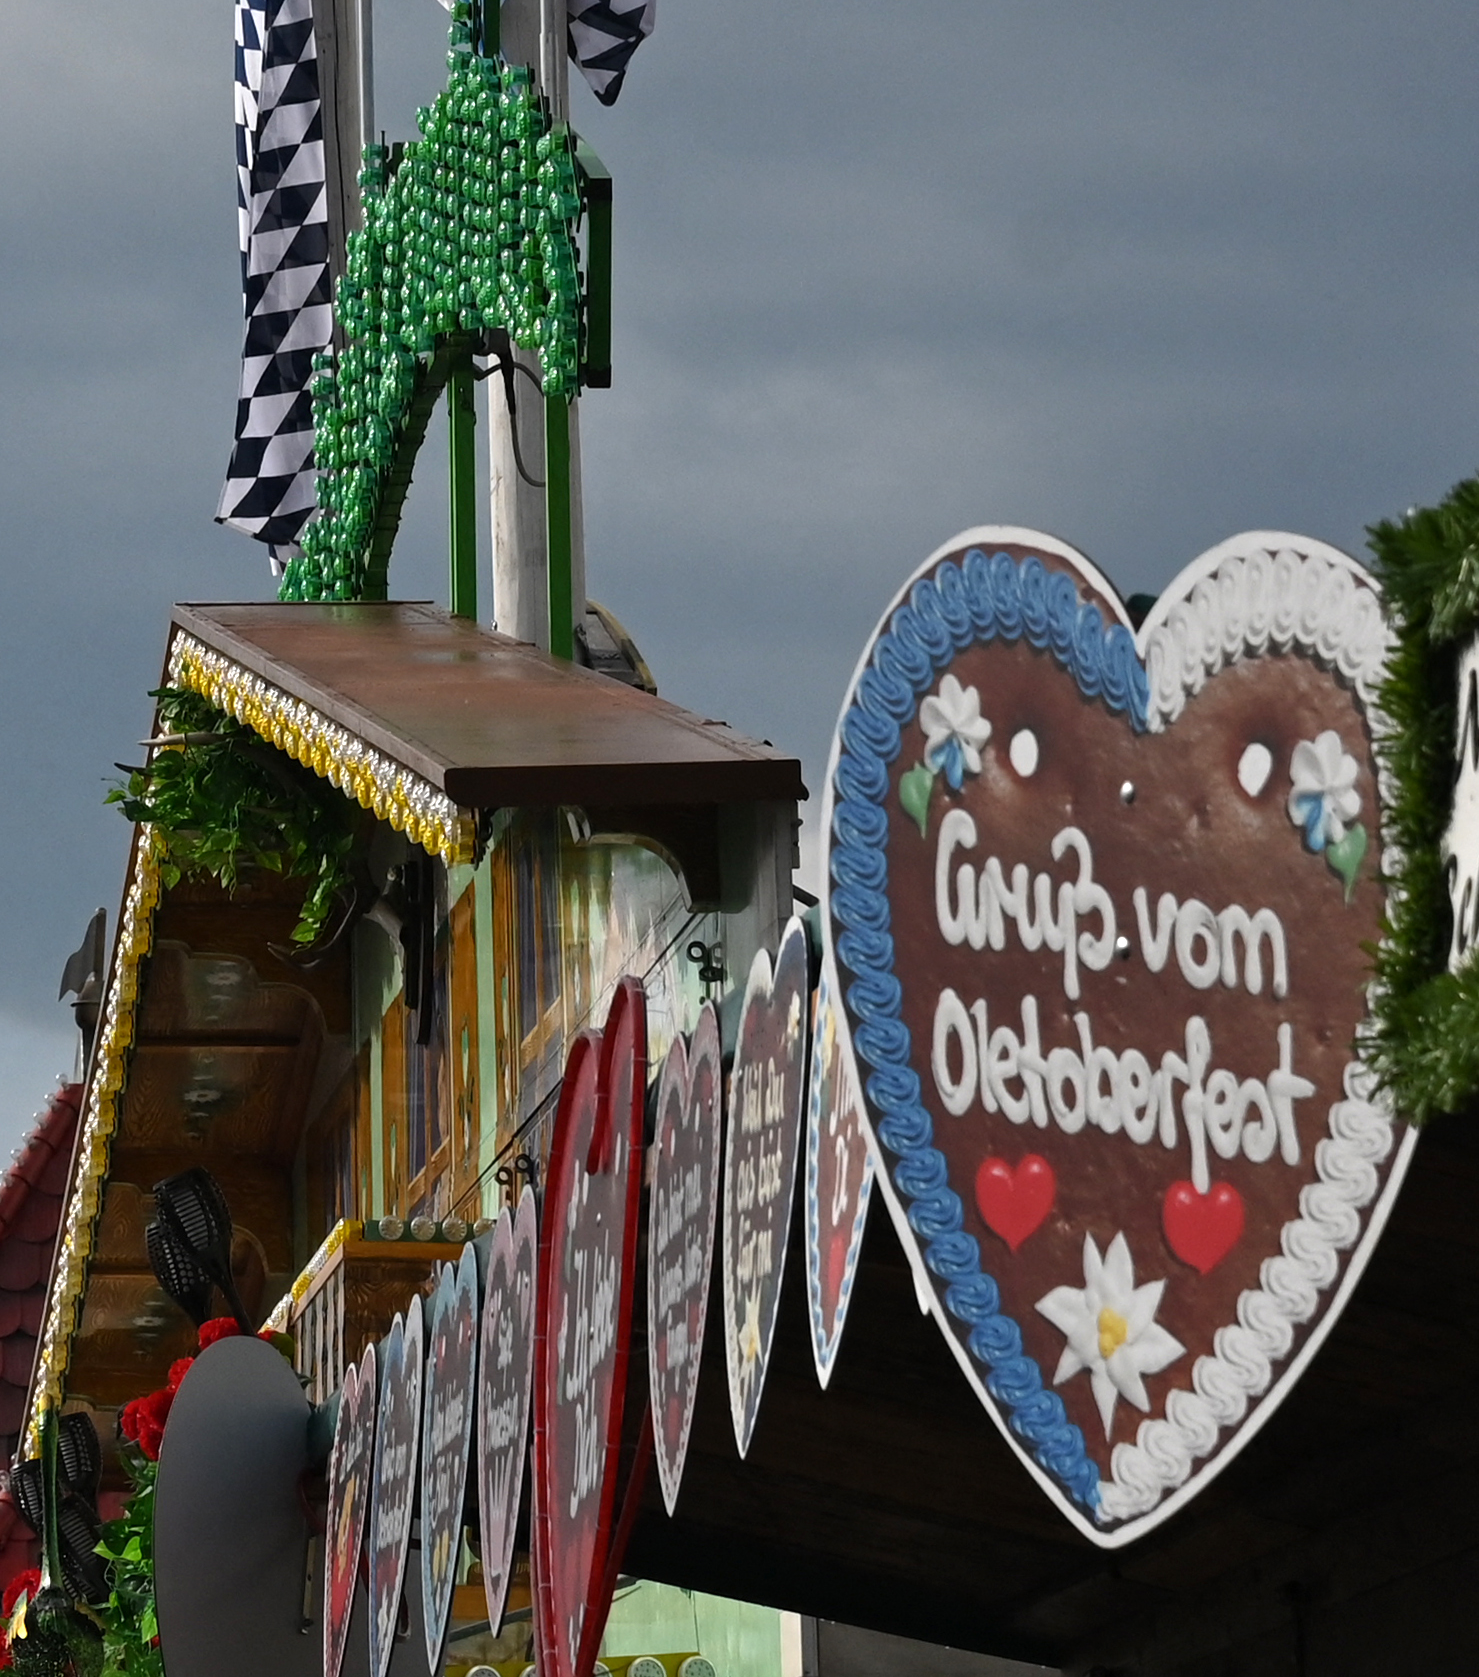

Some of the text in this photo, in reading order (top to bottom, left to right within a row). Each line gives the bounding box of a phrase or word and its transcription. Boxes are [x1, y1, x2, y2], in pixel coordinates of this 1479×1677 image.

[936, 808, 1289, 1000] Gruß vom
[932, 987, 1316, 1194] Oktoberfest
[757, 1126, 783, 1207] bist
[589, 1228, 616, 1377] liebe
[570, 1379, 599, 1519] Dich
